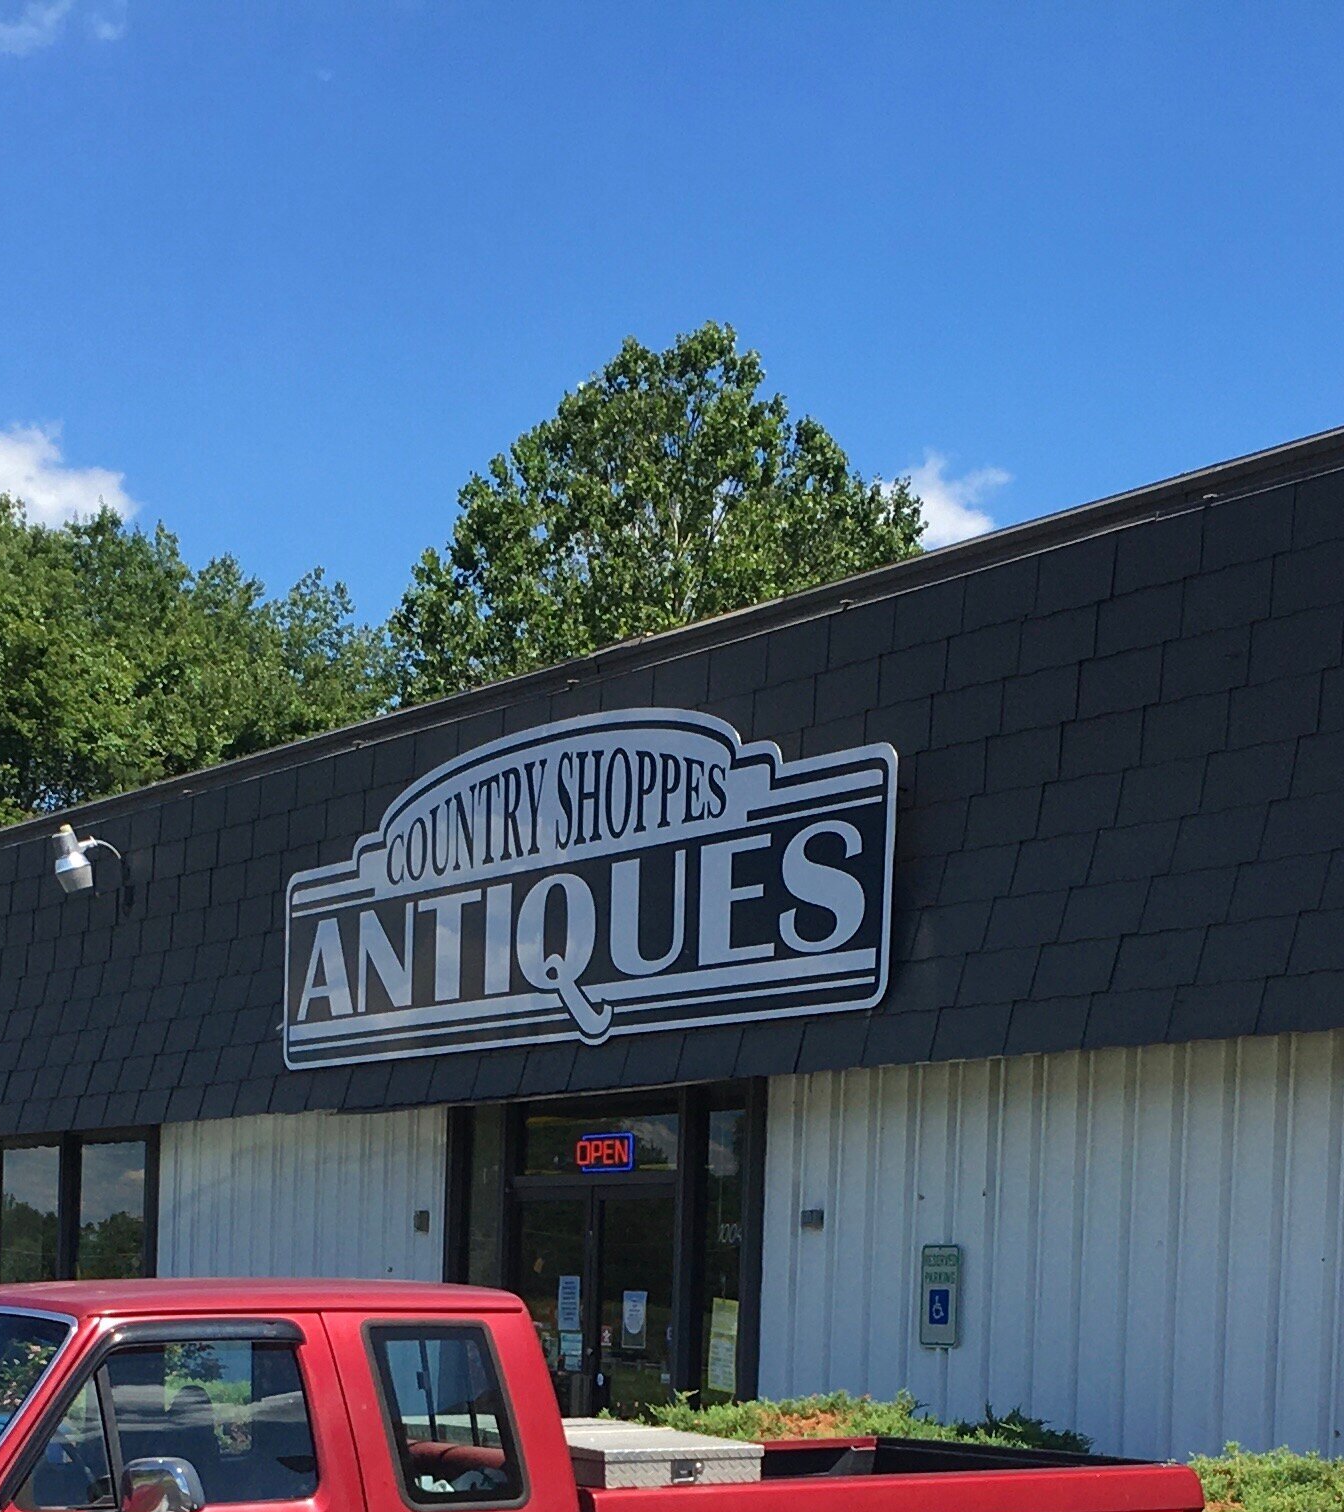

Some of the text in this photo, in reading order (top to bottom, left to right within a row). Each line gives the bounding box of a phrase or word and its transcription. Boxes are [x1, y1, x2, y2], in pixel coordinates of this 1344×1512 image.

[386, 747, 728, 887] COUNTRY SHOPPES
[296, 820, 866, 1038] ANTIQUES
[576, 1139, 629, 1166] OPEN
